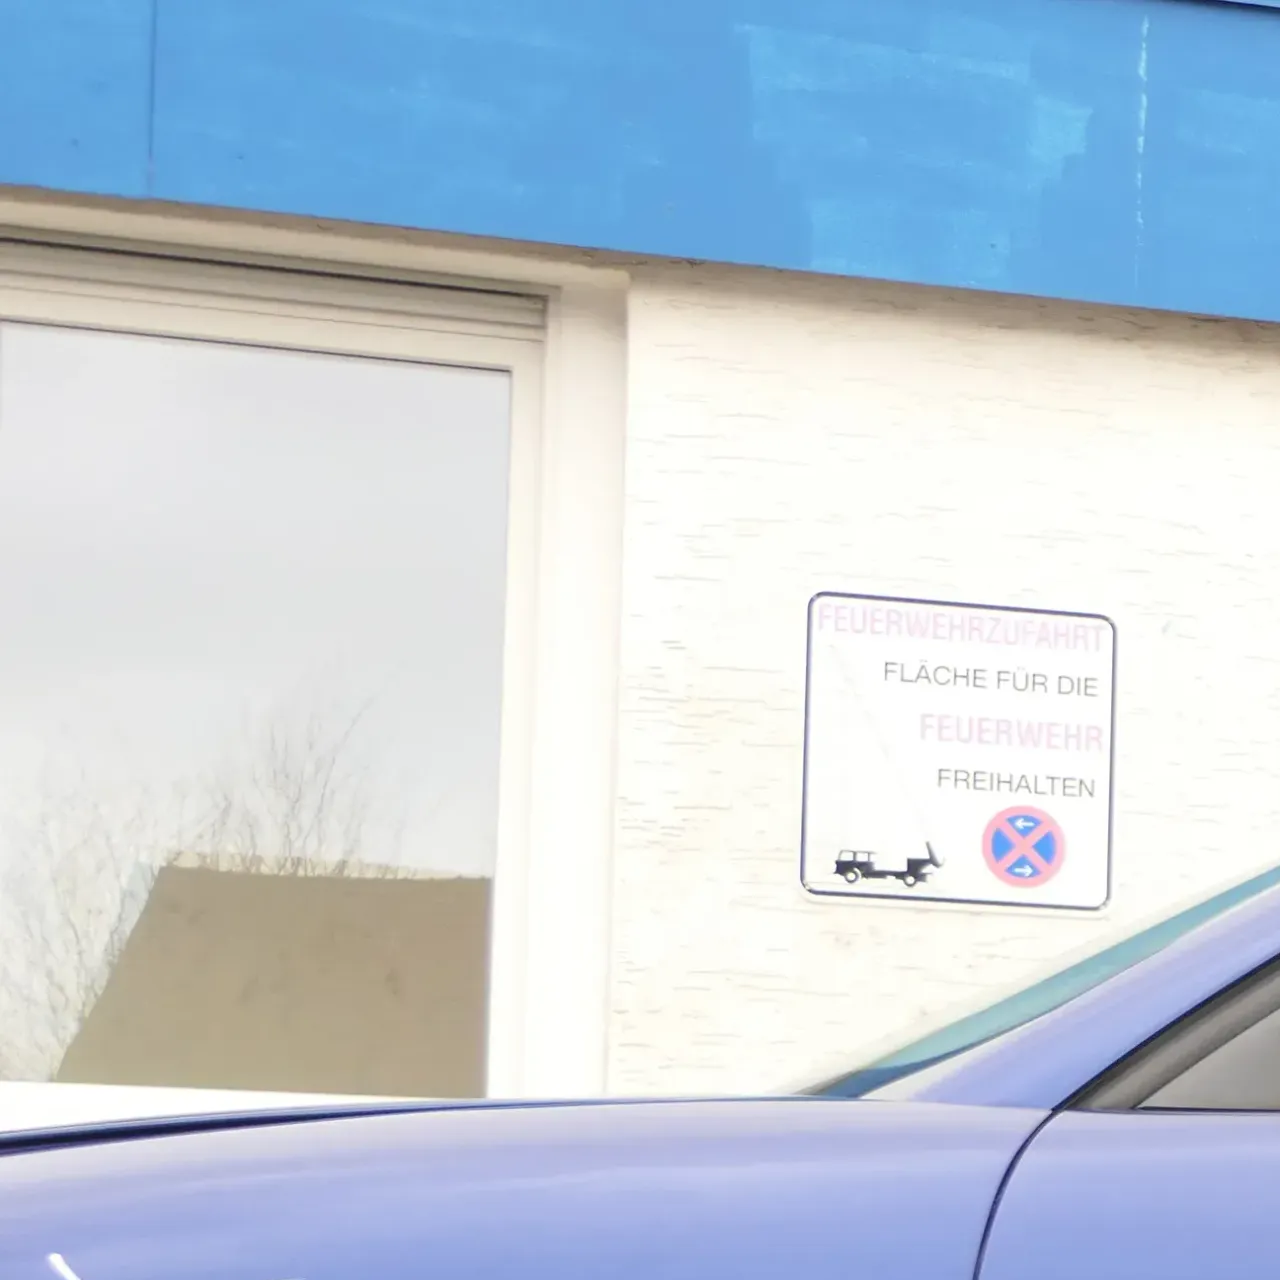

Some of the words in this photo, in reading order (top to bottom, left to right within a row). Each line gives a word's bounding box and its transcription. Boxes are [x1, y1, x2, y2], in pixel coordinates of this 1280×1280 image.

[817, 603, 1102, 651] FEUERWEHRZUFAHRT
[884, 660, 988, 689] FLÄCHE
[996, 667, 1048, 693] FÜR
[1057, 675, 1099, 697] DIE
[919, 713, 1103, 752] FEUERWEHR
[936, 768, 1096, 799] FREIHALTEN
